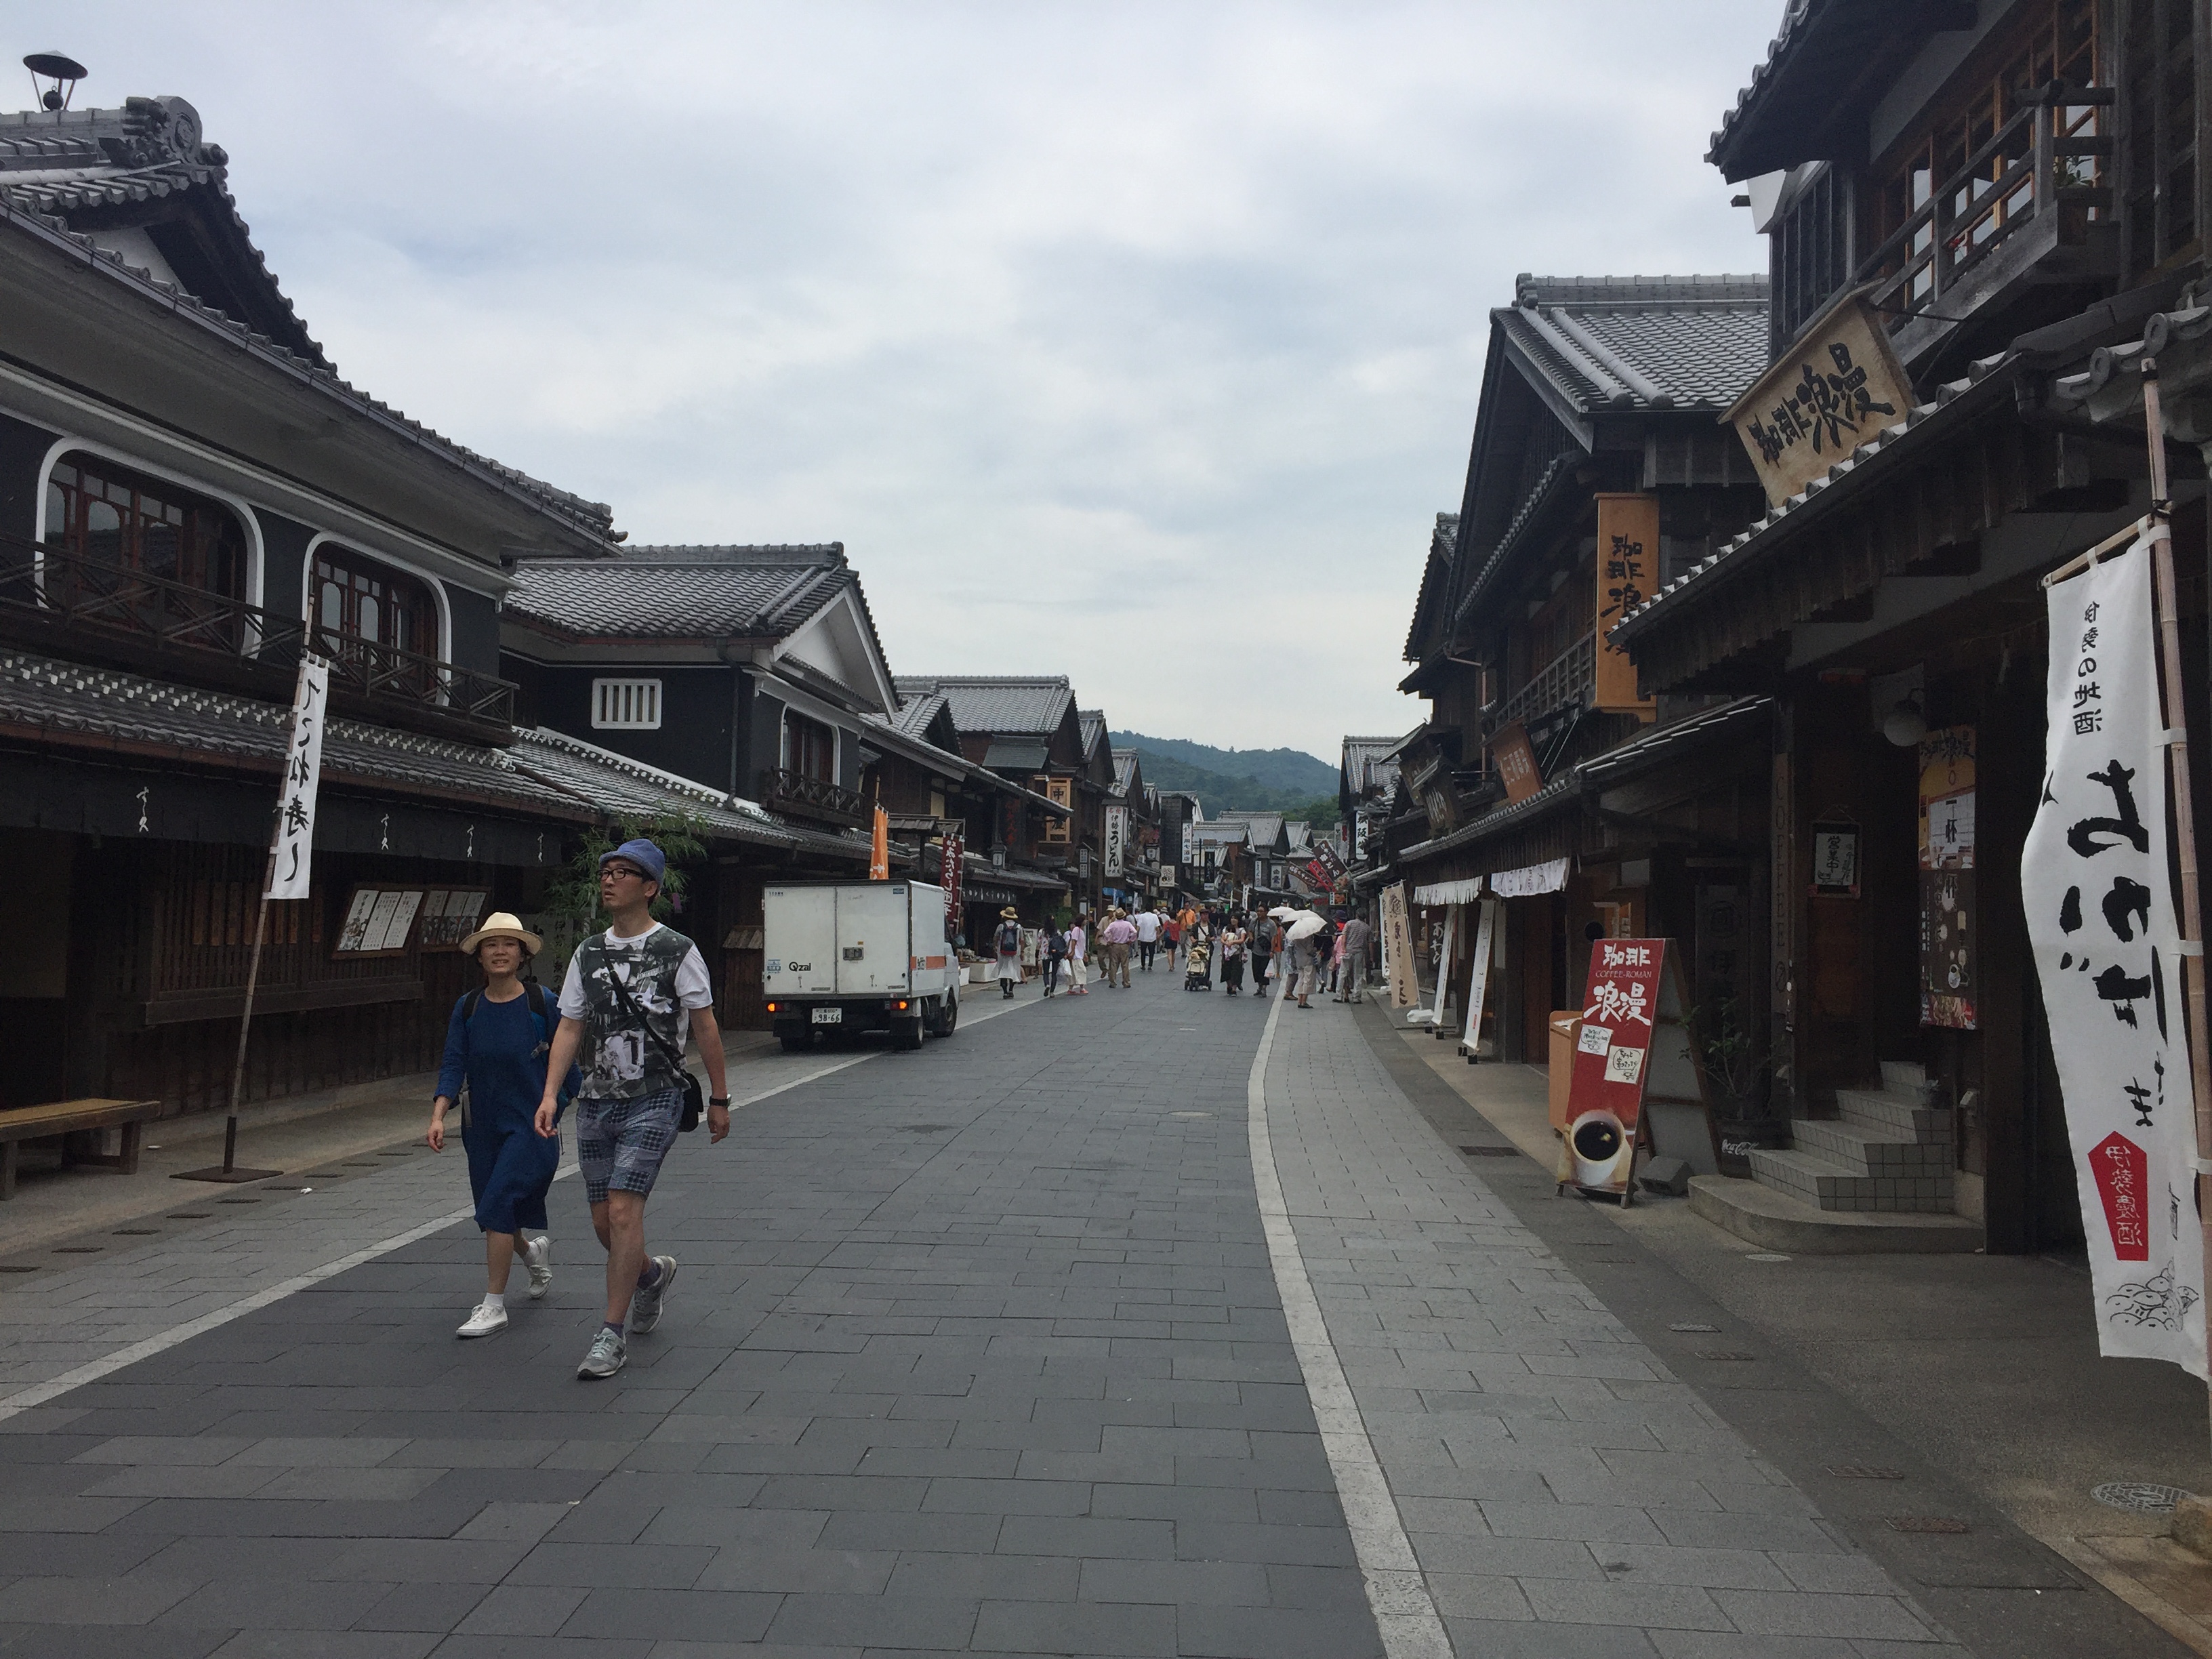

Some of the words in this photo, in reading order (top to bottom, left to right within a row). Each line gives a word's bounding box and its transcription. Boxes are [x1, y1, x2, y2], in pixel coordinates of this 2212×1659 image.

[1747, 342, 1896, 469] 珈琲浪漫
[1109, 815, 1120, 867] 伊勢うどん
[789, 962, 811, 971] Qzal
[1595, 970, 1652, 979] COFFEE-ROMAN
[1603, 943, 1650, 970] 珈琲
[1583, 980, 1651, 1026] 浪漫
